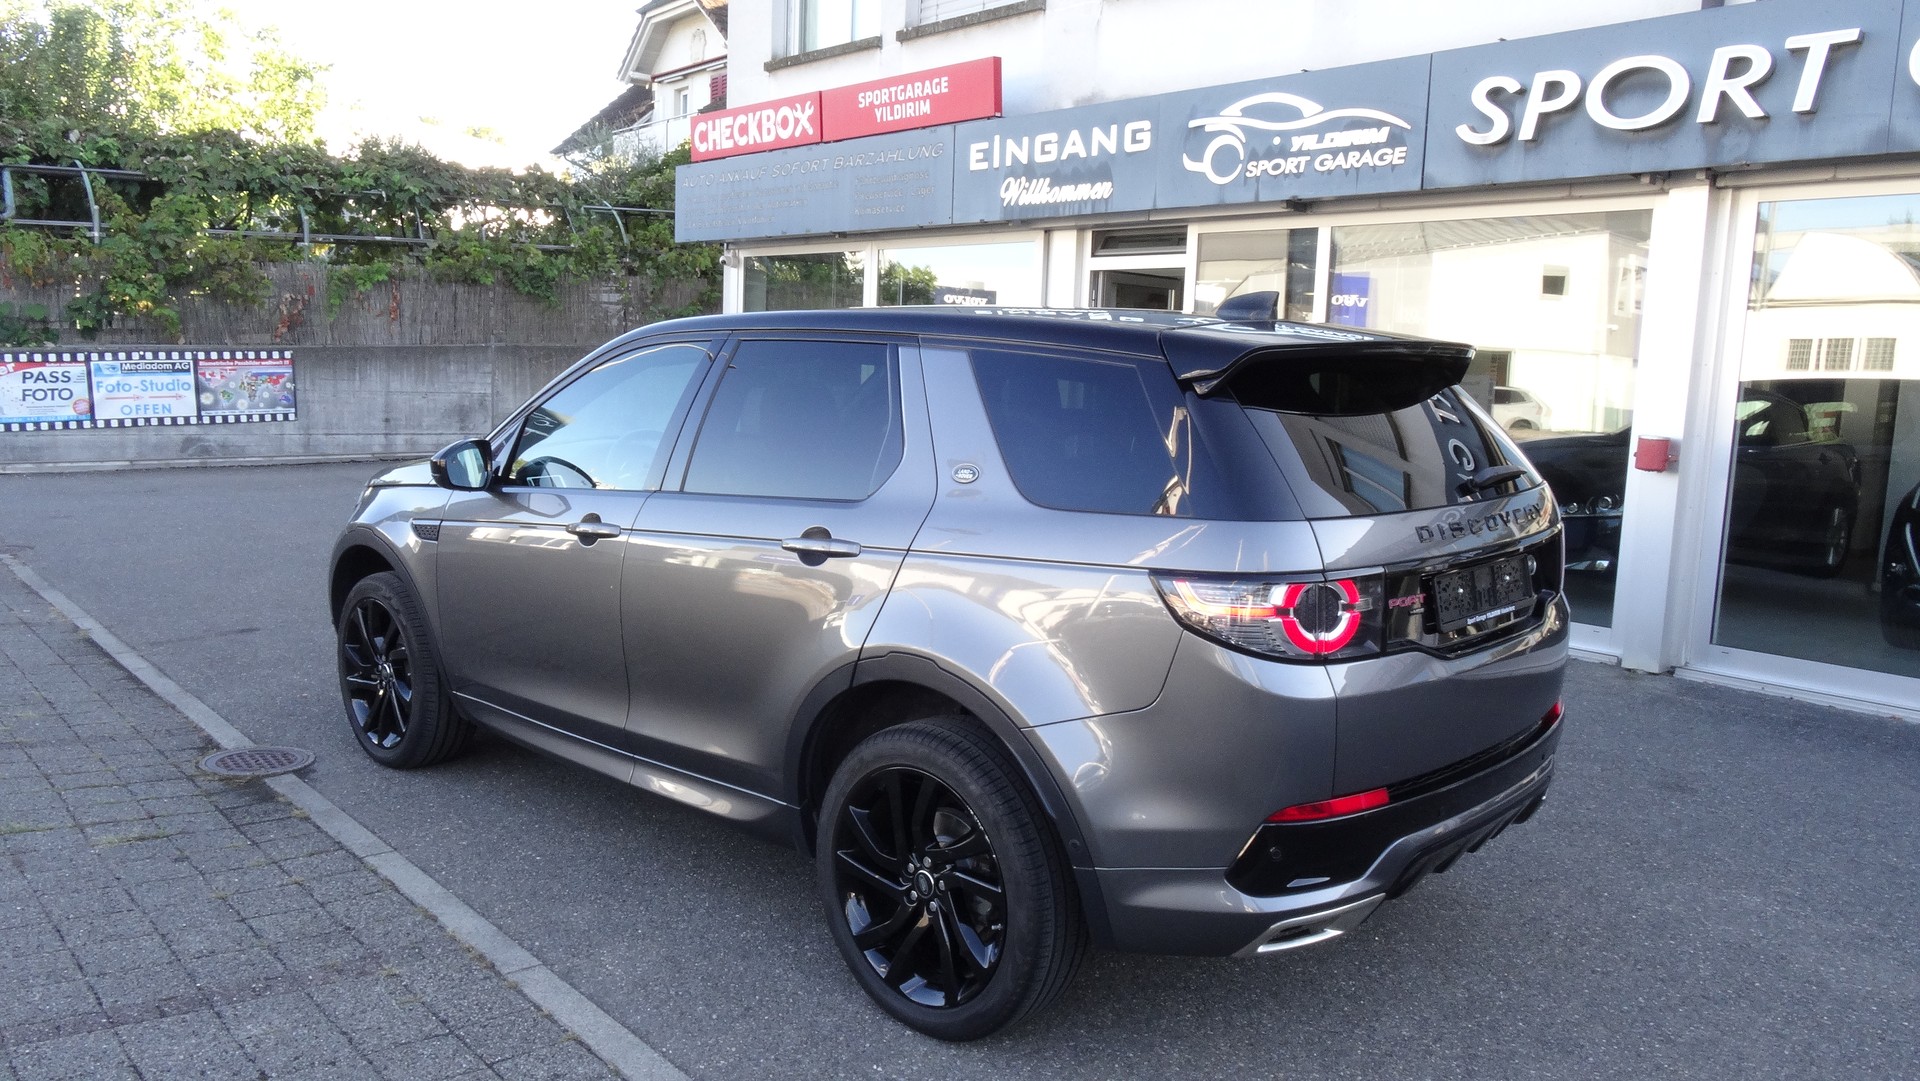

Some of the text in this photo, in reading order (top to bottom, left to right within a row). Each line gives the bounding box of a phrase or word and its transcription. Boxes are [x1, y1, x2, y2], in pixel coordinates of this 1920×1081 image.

[857, 76, 949, 108] SPORTGARAGE
[1455, 27, 1864, 146] SPORT
[694, 100, 815, 153] CHECKBOX
[874, 98, 931, 123] YILDIRIM
[969, 119, 1152, 171] EINGANG
[682, 173, 714, 188] AUTO
[771, 158, 830, 178] SOFORT
[833, 142, 944, 170] BARZAHLUNG
[1245, 146, 1408, 178] SPORT GARAGE
[1000, 175, 1114, 208] Willkommen
[22, 370, 71, 384] PASS
[121, 362, 173, 371] Mediadom
[174, 362, 190, 370] AG
[22, 387, 74, 402] FOTO
[96, 379, 192, 393] Foto-Studio
[120, 403, 172, 416] OFFEN
[1414, 502, 1543, 544] DISCOVERY
